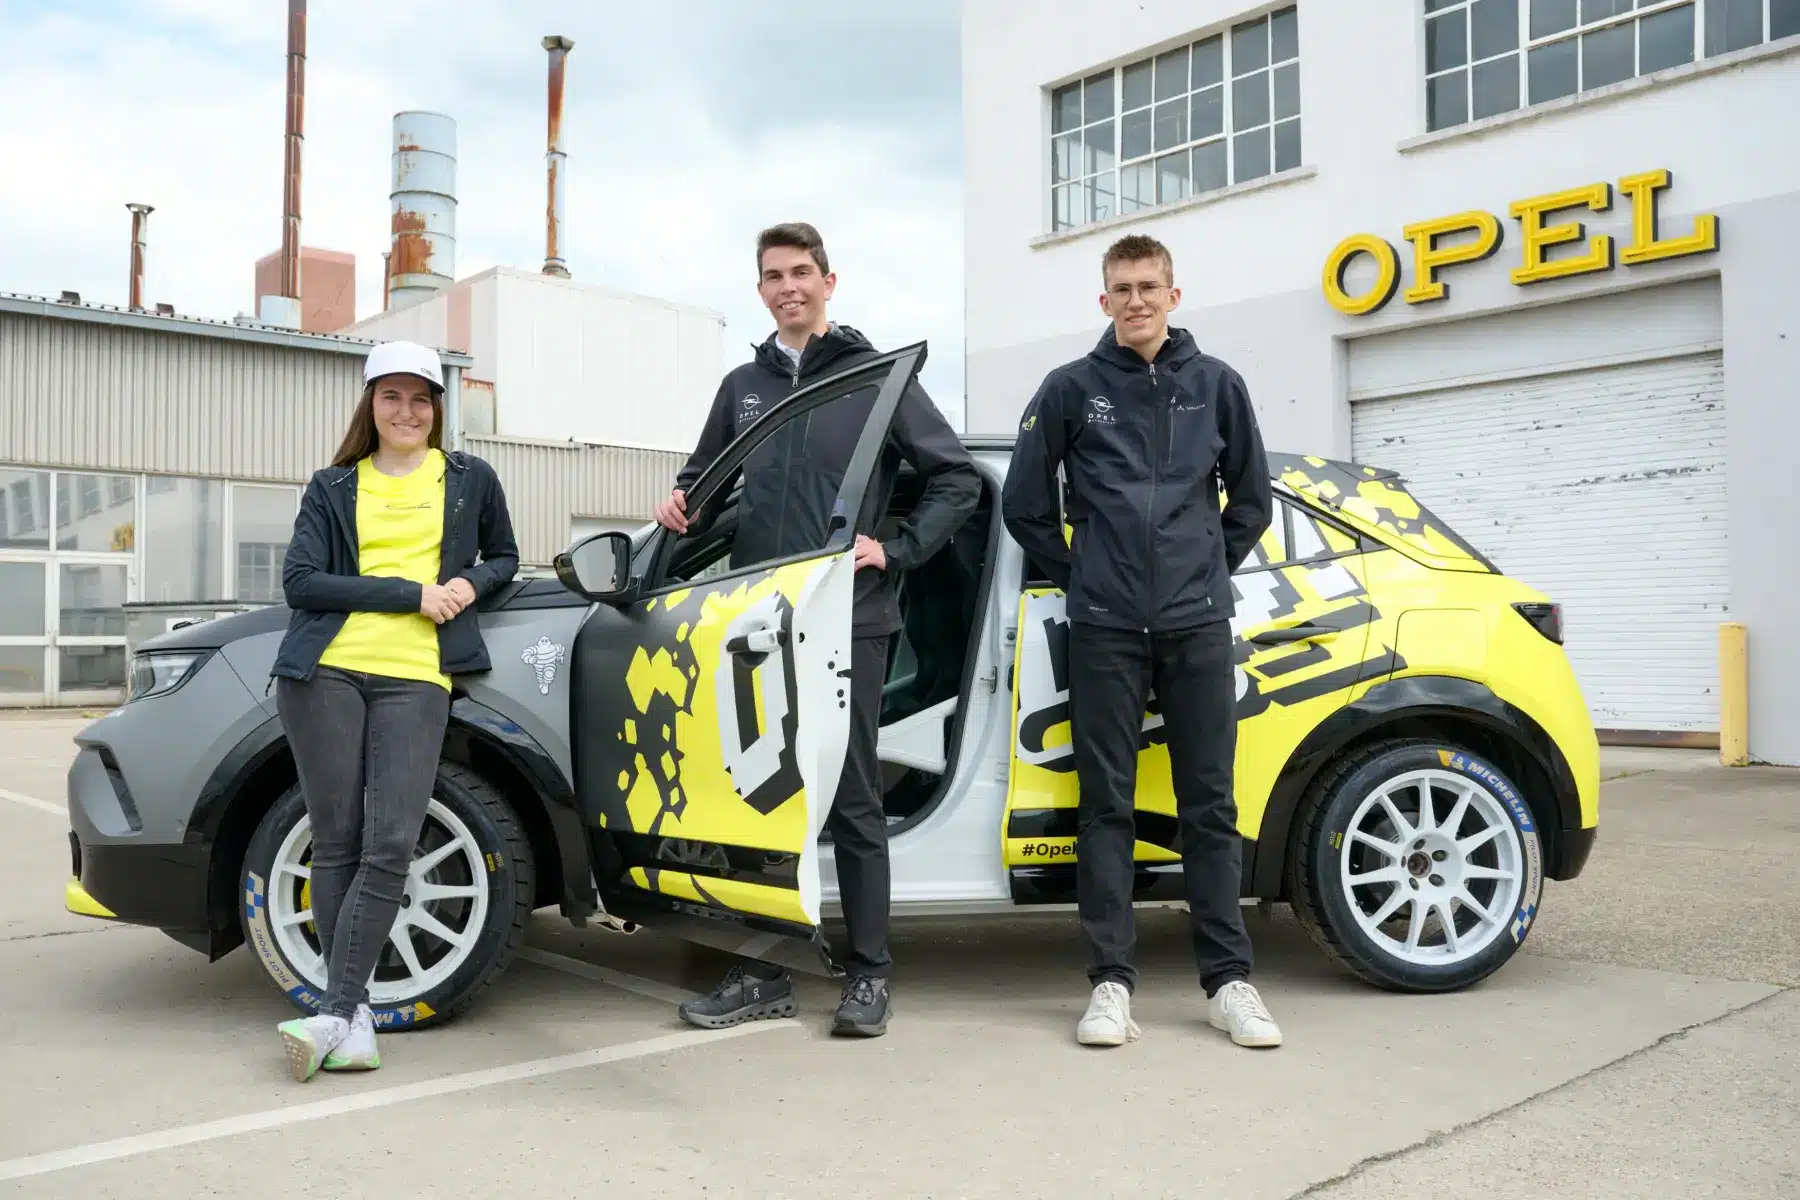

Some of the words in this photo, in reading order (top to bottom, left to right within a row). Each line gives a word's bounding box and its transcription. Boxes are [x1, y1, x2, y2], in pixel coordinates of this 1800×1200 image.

[1322, 168, 1720, 316] OPEL
[739, 410, 760, 419] OPEL
[1088, 413, 1116, 421] OPEL
[1467, 761, 1531, 825] MICHELIN
[1022, 841, 1077, 858] #Opel
[1529, 839, 1537, 863] PILOT
[1531, 867, 1539, 895] SPORT
[255, 927, 272, 958] SPORT
[268, 960, 290, 984] PILOT
